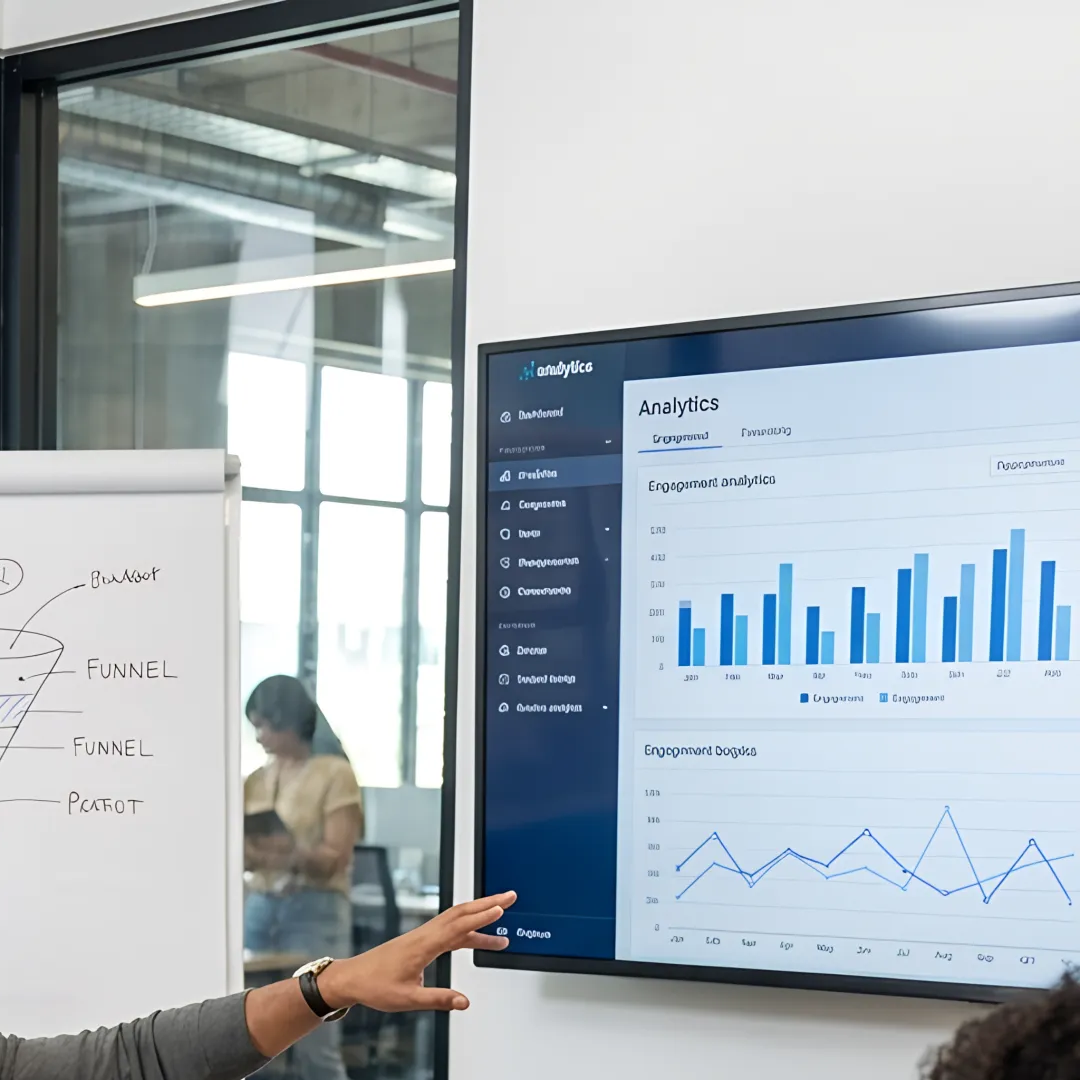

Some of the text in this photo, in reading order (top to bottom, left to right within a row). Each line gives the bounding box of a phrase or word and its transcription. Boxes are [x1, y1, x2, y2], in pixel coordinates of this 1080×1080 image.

[639, 396, 719, 417] Analytics
[87, 658, 178, 680] FUNNEL
[73, 736, 154, 757] FUNNEL
